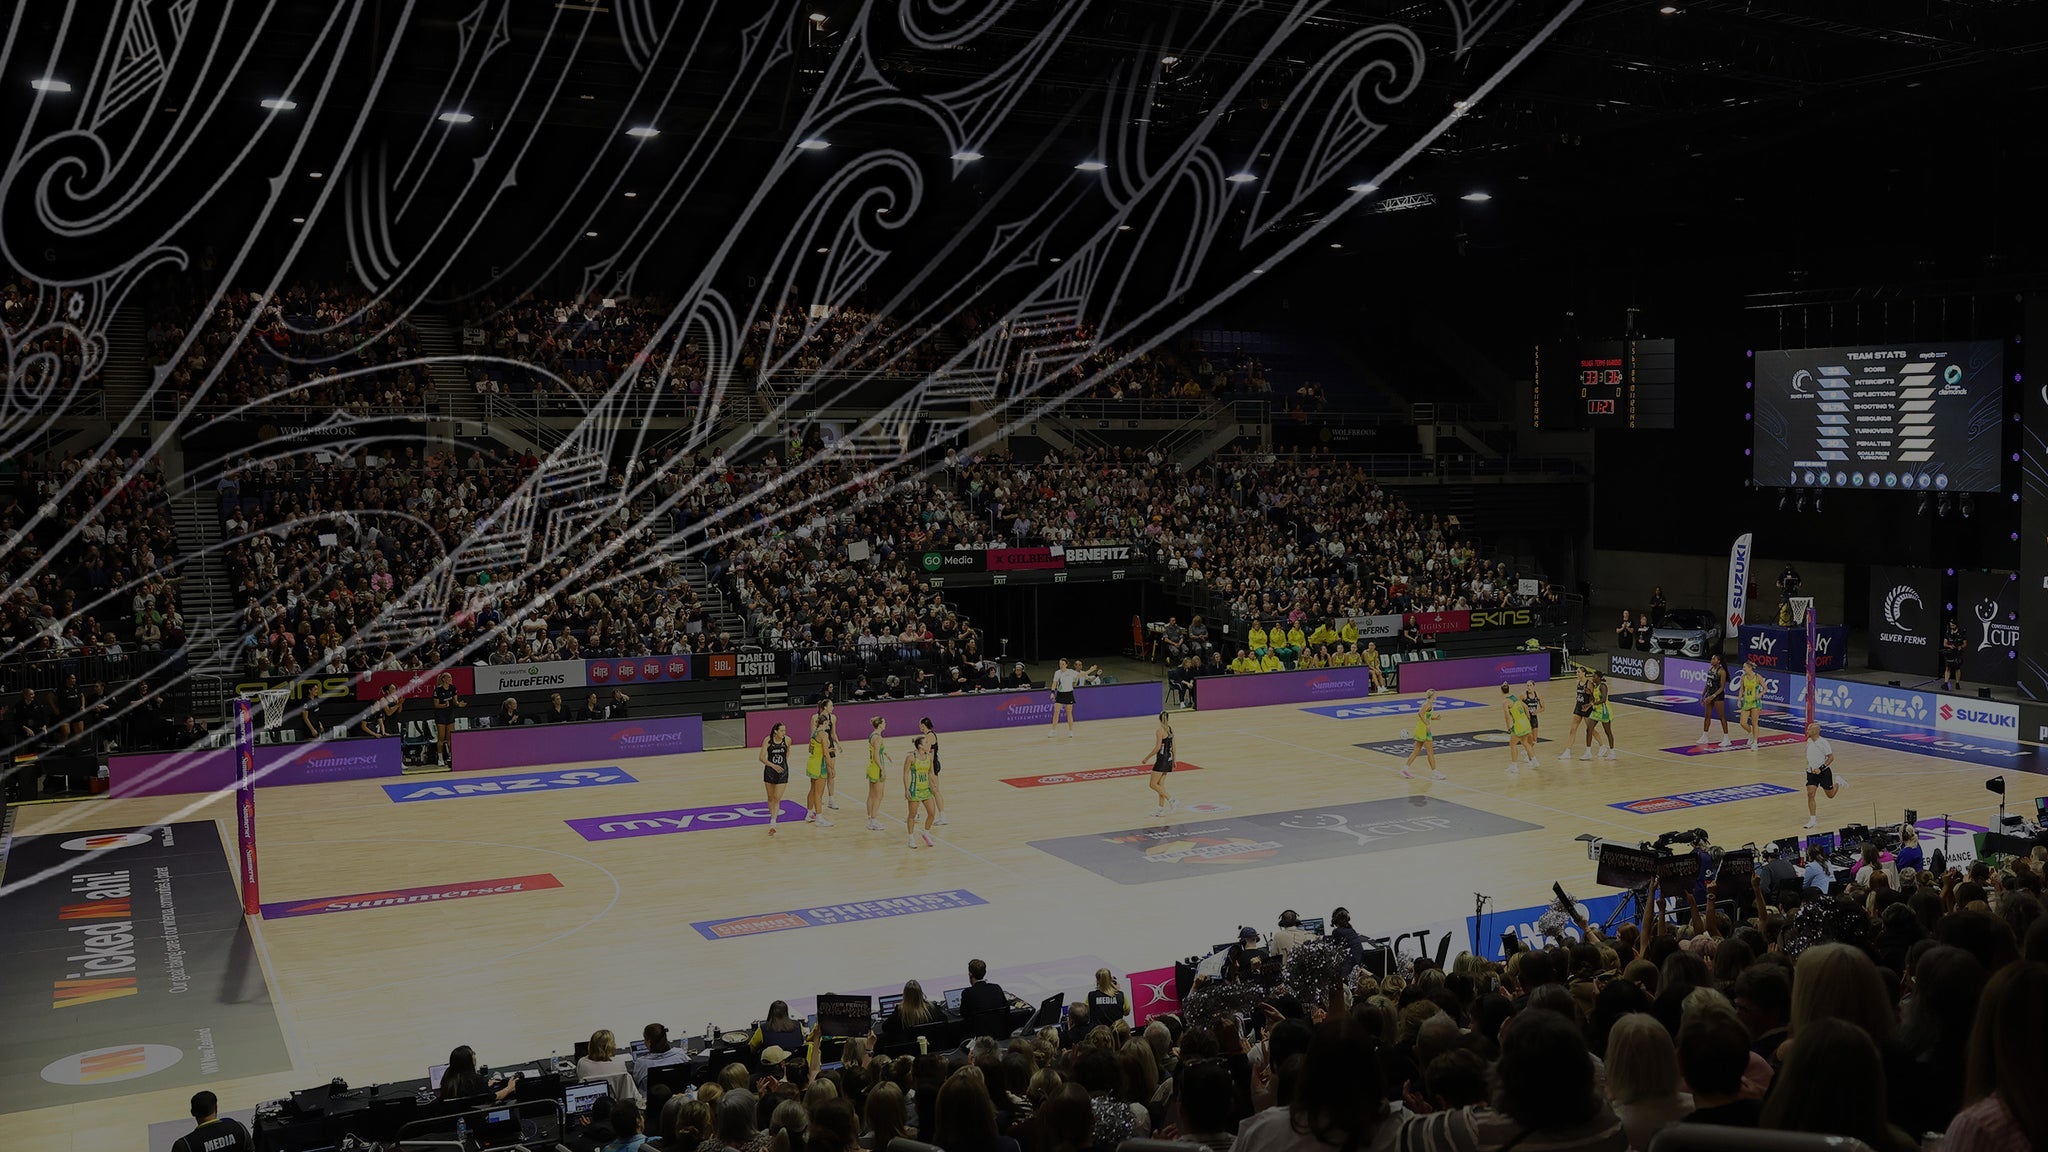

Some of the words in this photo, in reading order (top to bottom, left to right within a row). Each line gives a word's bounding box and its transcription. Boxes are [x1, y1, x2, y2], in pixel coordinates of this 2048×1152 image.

[1874, 351, 1906, 359] STATS
[280, 426, 356, 436] WOLFBROOK
[1332, 428, 1376, 436] WOLFBROOK
[924, 556, 940, 565] GO
[944, 555, 973, 565] Media
[1065, 547, 1130, 562] BENEFITZ
[1733, 544, 1746, 609] SUZUKI
[1470, 609, 1531, 628] SKINS
[1418, 622, 1459, 631] UGUSTINE
[1750, 633, 1776, 651] sky
[1815, 633, 1832, 651] ky
[1880, 633, 1901, 643] SILVER
[1904, 635, 1926, 646] FERNS
[1991, 630, 2020, 646] CUP
[737, 654, 762, 663] DARE
[763, 652, 775, 661] TO
[1612, 656, 1643, 667] MANUKA
[1748, 653, 1778, 667] SPORT
[714, 660, 731, 671] JBL
[737, 662, 775, 676] LISTEN
[1500, 665, 1538, 674] Summerset
[1612, 666, 1643, 677] DOCTOR
[499, 674, 564, 690] futureFERNS
[1312, 679, 1355, 690] Summerset
[1868, 696, 1907, 717] ANZ
[1957, 709, 2016, 728] SUZUKI
[620, 731, 683, 745] Summerset
[307, 754, 377, 769] Summerset
[773, 755, 783, 764] GD
[403, 777, 548, 799] ANZ
[599, 807, 786, 833] myob
[1368, 818, 1450, 835] CUP
[246, 849, 255, 884] Summerset
[324, 882, 526, 911] Summerset
[807, 890, 960, 919] CHEMIST
[53, 921, 138, 1008] Wicked
[170, 982, 189, 993] Our
[1096, 996, 1118, 1005] MEDIA
[204, 1134, 236, 1152] MEDIA
